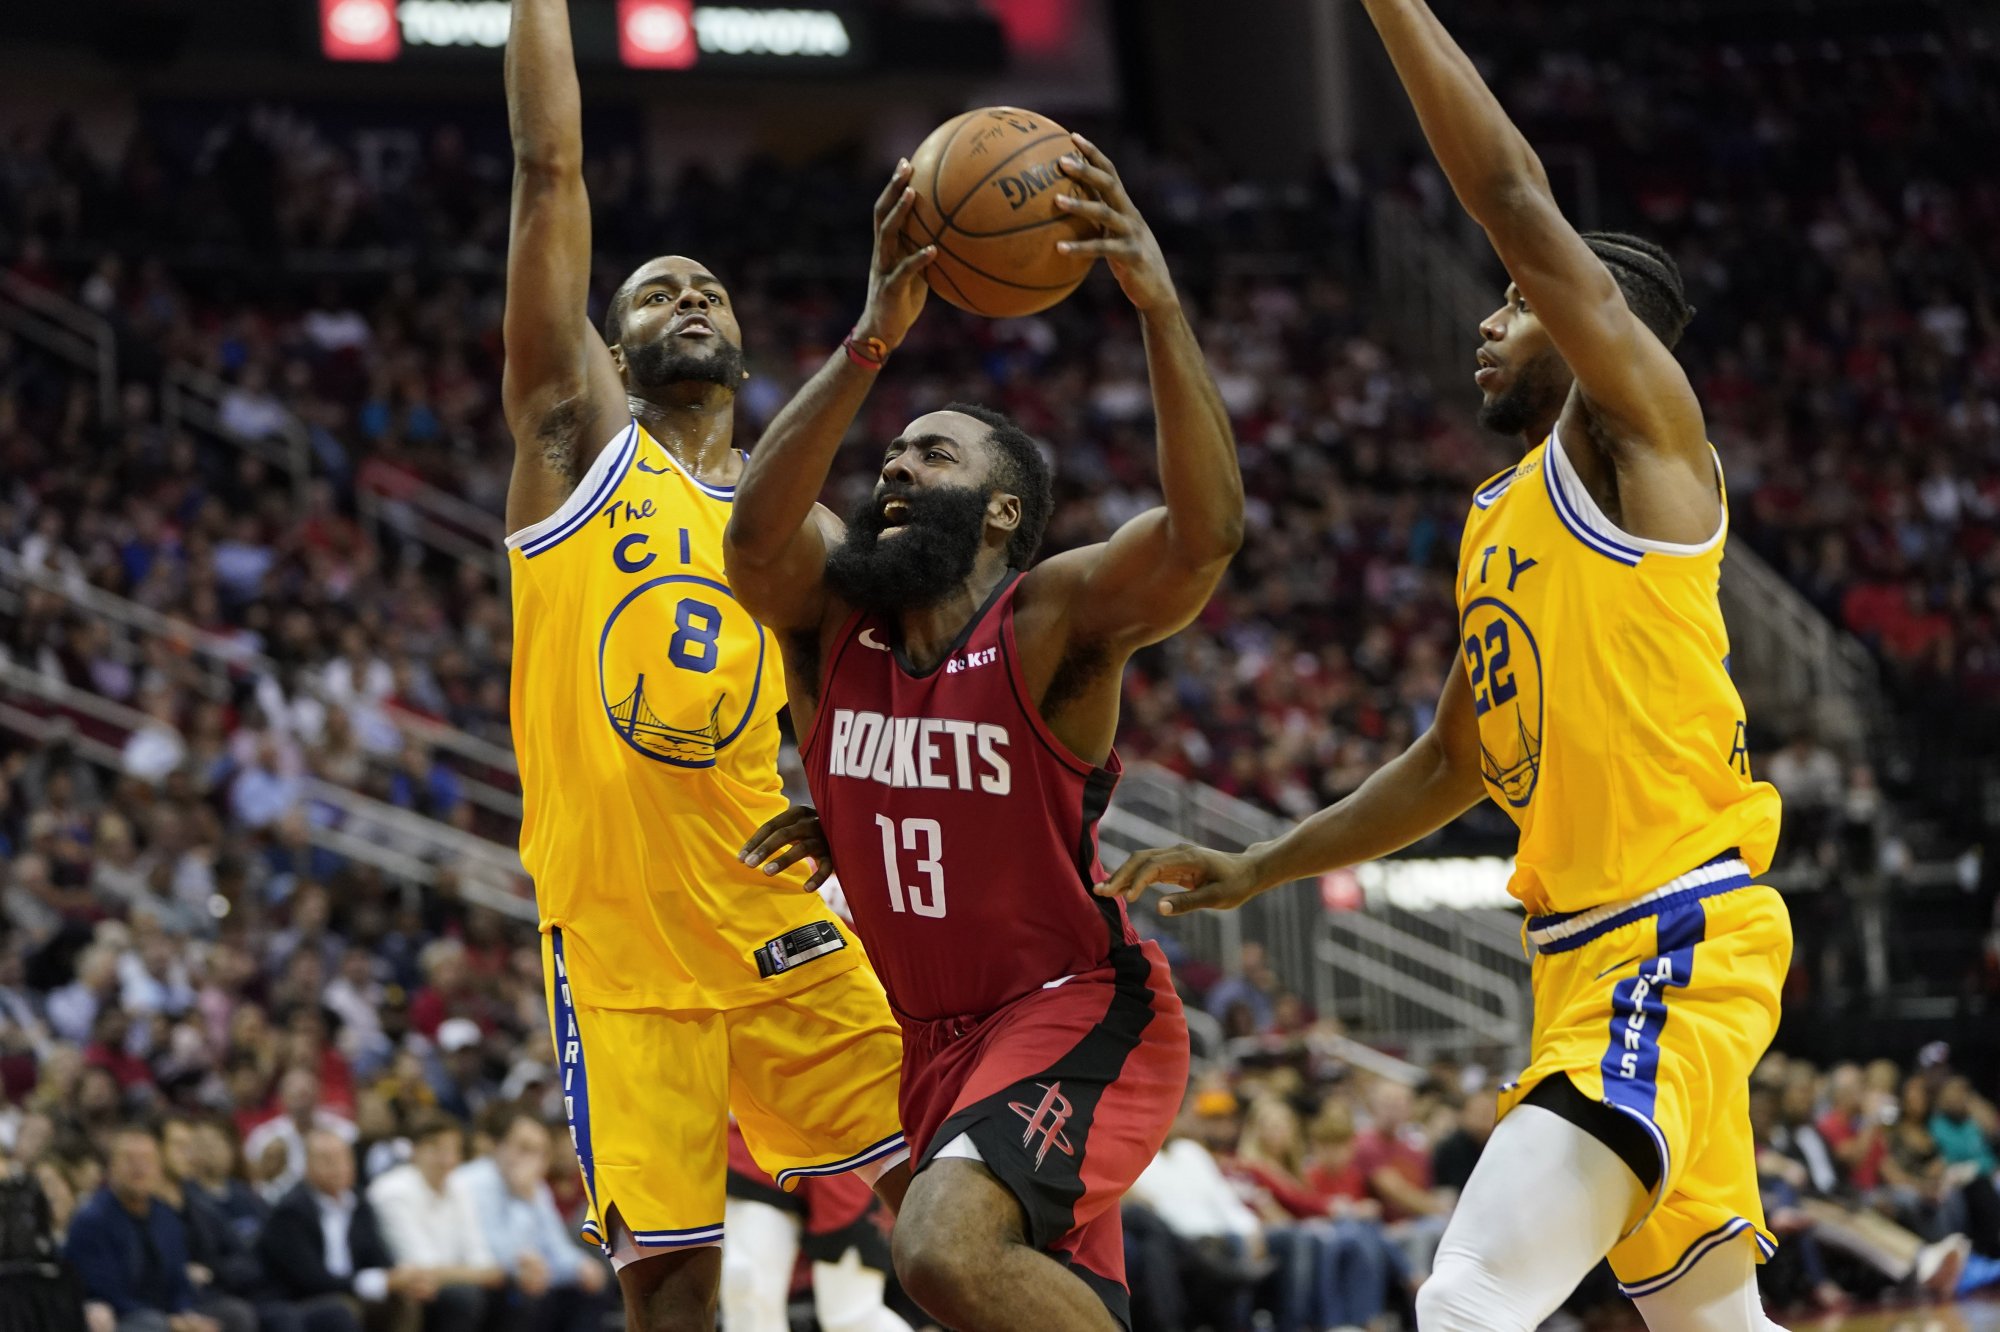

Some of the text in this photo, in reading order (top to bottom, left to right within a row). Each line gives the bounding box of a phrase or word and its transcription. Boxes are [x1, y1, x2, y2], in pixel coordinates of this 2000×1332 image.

[603, 499, 657, 528] The
[613, 528, 690, 573] CI
[668, 597, 722, 673] 8
[1466, 618, 1518, 717] 22
[829, 708, 1011, 796] ROCKETS
[875, 813, 947, 918] 13
